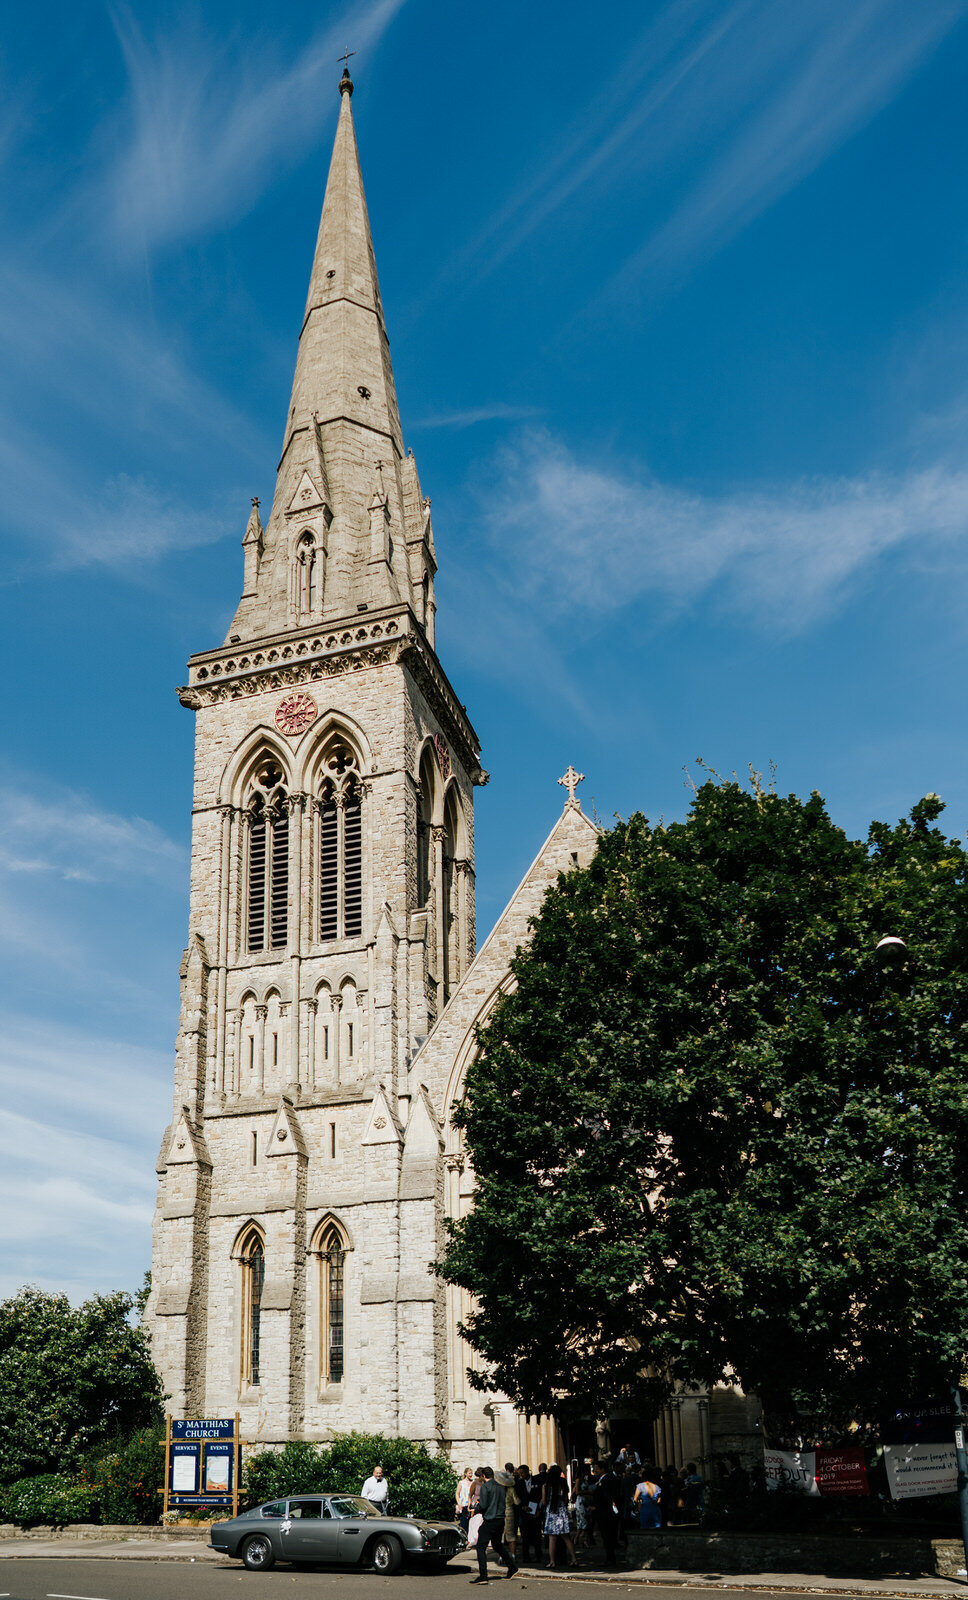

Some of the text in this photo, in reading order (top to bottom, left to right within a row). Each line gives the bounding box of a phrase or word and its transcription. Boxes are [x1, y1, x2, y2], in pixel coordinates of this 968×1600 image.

[187, 1420, 229, 1428] MATTHIAS
[820, 1456, 843, 1464] FRIDAY
[930, 1452, 947, 1462] forget
[825, 1463, 860, 1471] OCTOBER
[913, 1463, 946, 1471] recommend
[781, 1468, 810, 1481] OUT
